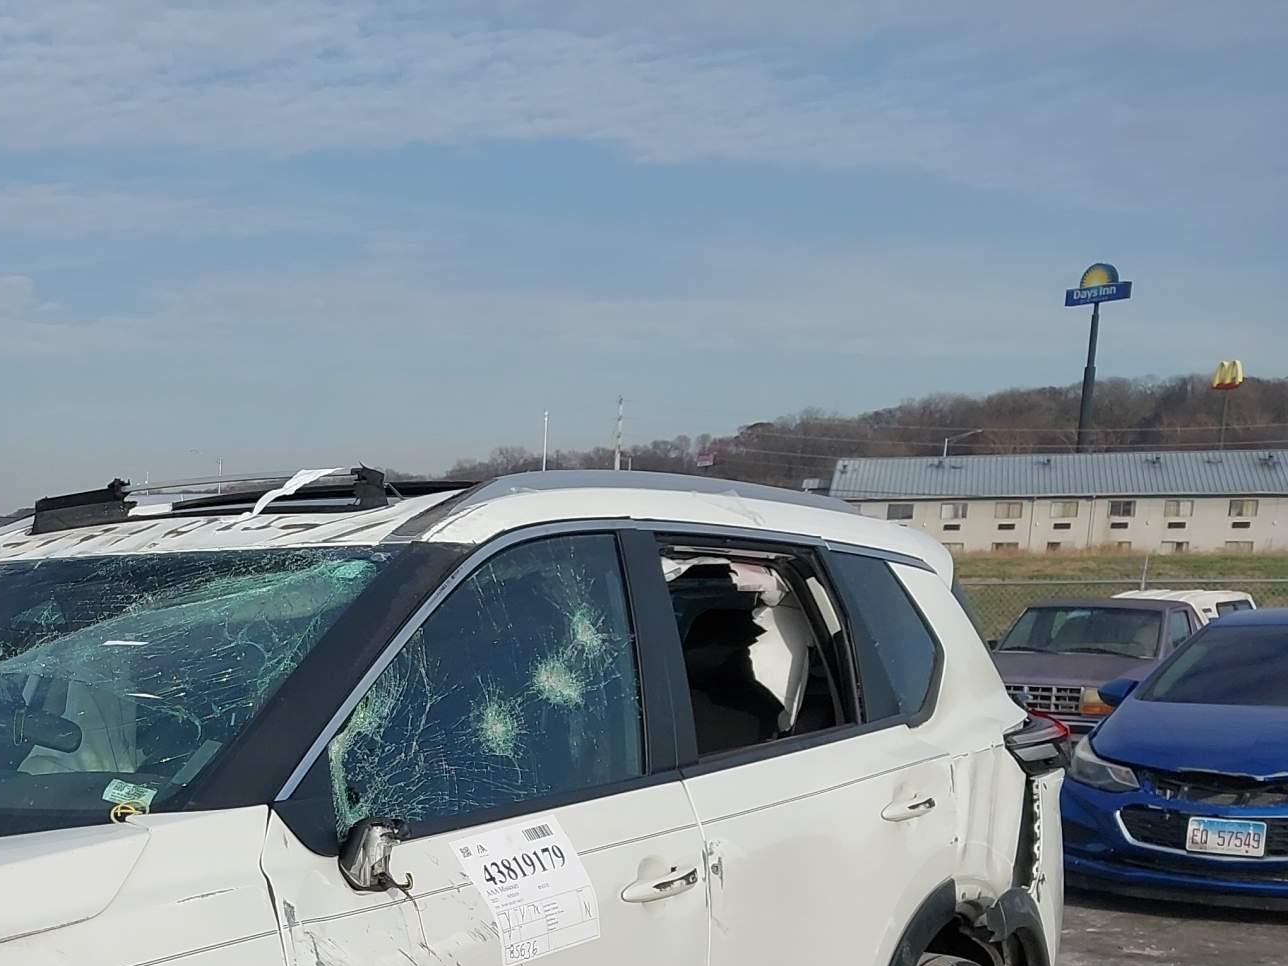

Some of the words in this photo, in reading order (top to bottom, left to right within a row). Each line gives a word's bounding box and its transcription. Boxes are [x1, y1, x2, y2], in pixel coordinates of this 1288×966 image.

[1073, 289, 1098, 300] Days
[1099, 286, 1117, 297] Inn
[1216, 830, 1261, 850] 57549
[483, 844, 566, 886] 43819179
